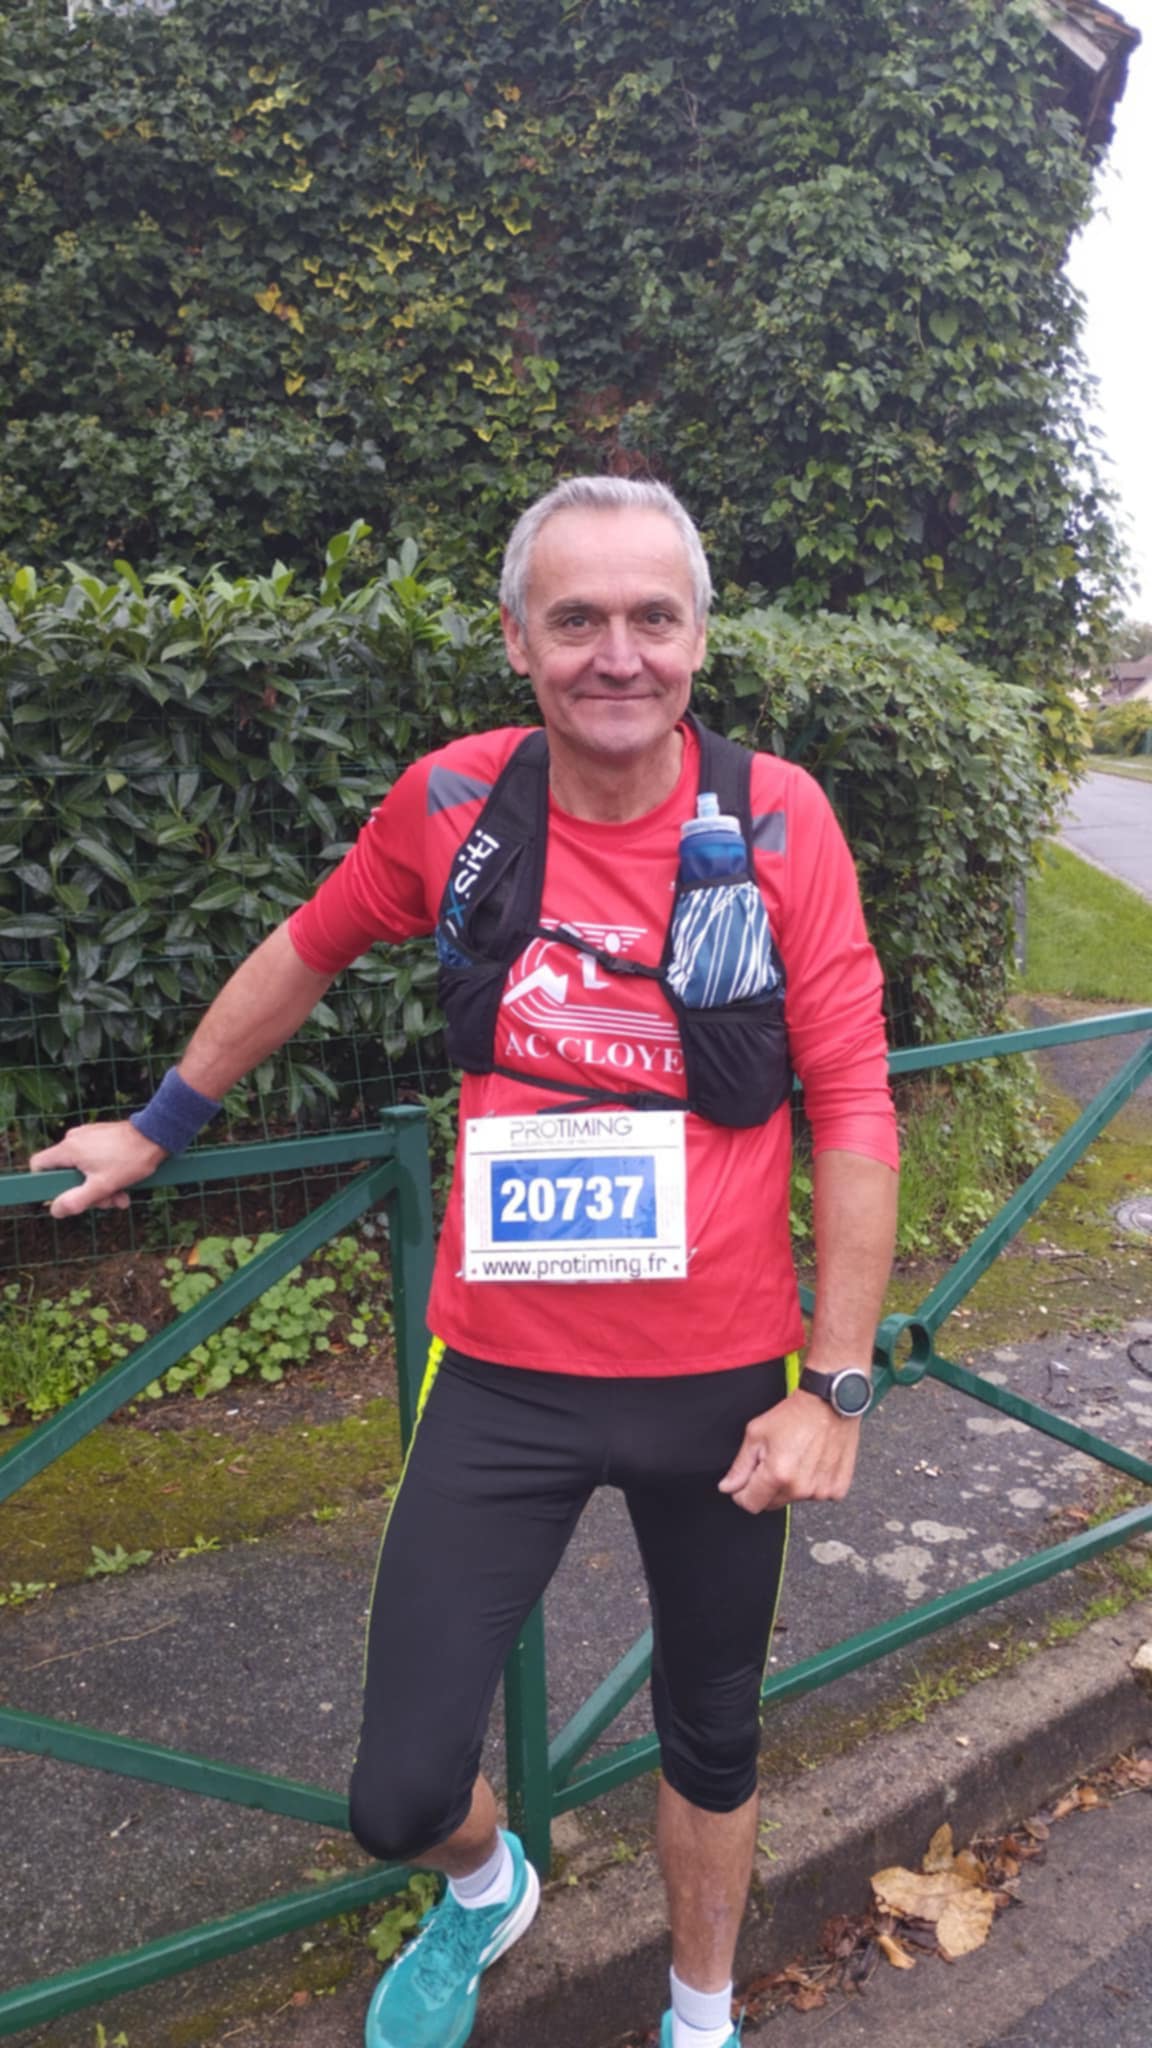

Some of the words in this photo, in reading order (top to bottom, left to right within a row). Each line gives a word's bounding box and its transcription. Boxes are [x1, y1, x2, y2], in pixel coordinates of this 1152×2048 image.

[504, 1031, 550, 1059] AC
[510, 1116, 633, 1140] PROTIMING
[500, 1176, 644, 1222] 20737
[482, 1253, 667, 1279] www.protiming.fr
